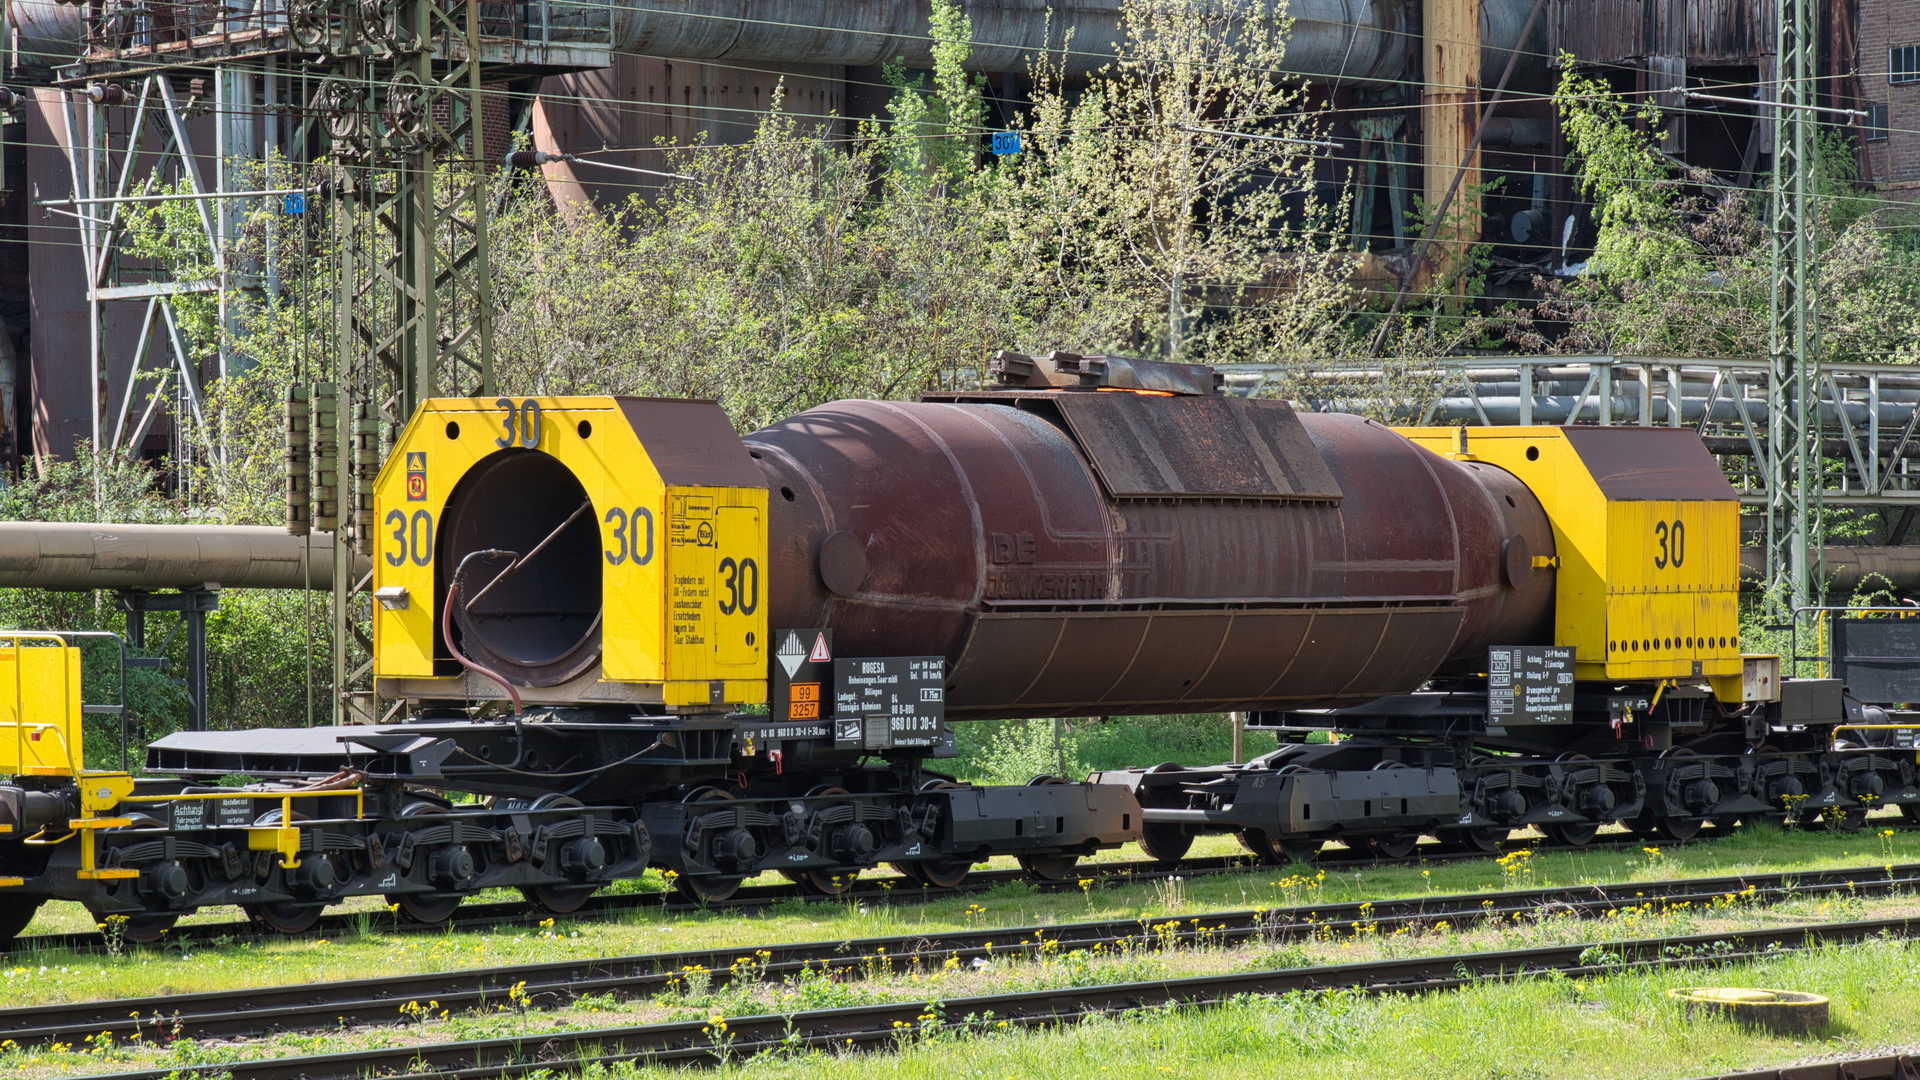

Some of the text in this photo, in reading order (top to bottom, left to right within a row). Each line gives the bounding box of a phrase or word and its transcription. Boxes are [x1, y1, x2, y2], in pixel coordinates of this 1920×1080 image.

[995, 135, 1017, 150] 307
[495, 397, 541, 449] 30
[384, 509, 433, 567] 30
[604, 507, 654, 566] 30
[1655, 520, 1685, 570] 30
[718, 556, 758, 616] 30
[699, 588, 709, 597] nicht
[674, 634, 704, 645] Saar Stahlbau
[862, 662, 885, 674] ROGESA
[909, 661, 920, 670] Leer
[929, 670, 942, 679] km/h
[799, 687, 811, 700] 99
[837, 692, 858, 703] Ladegut:
[864, 687, 882, 697] Dillingen
[793, 703, 816, 717] 3257
[861, 702, 881, 711] Roheisen
[891, 716, 905, 731] 960
[920, 716, 937, 730] 30-4
[1252, 776, 1266, 788] AS
[174, 804, 203, 816] Achtung!
